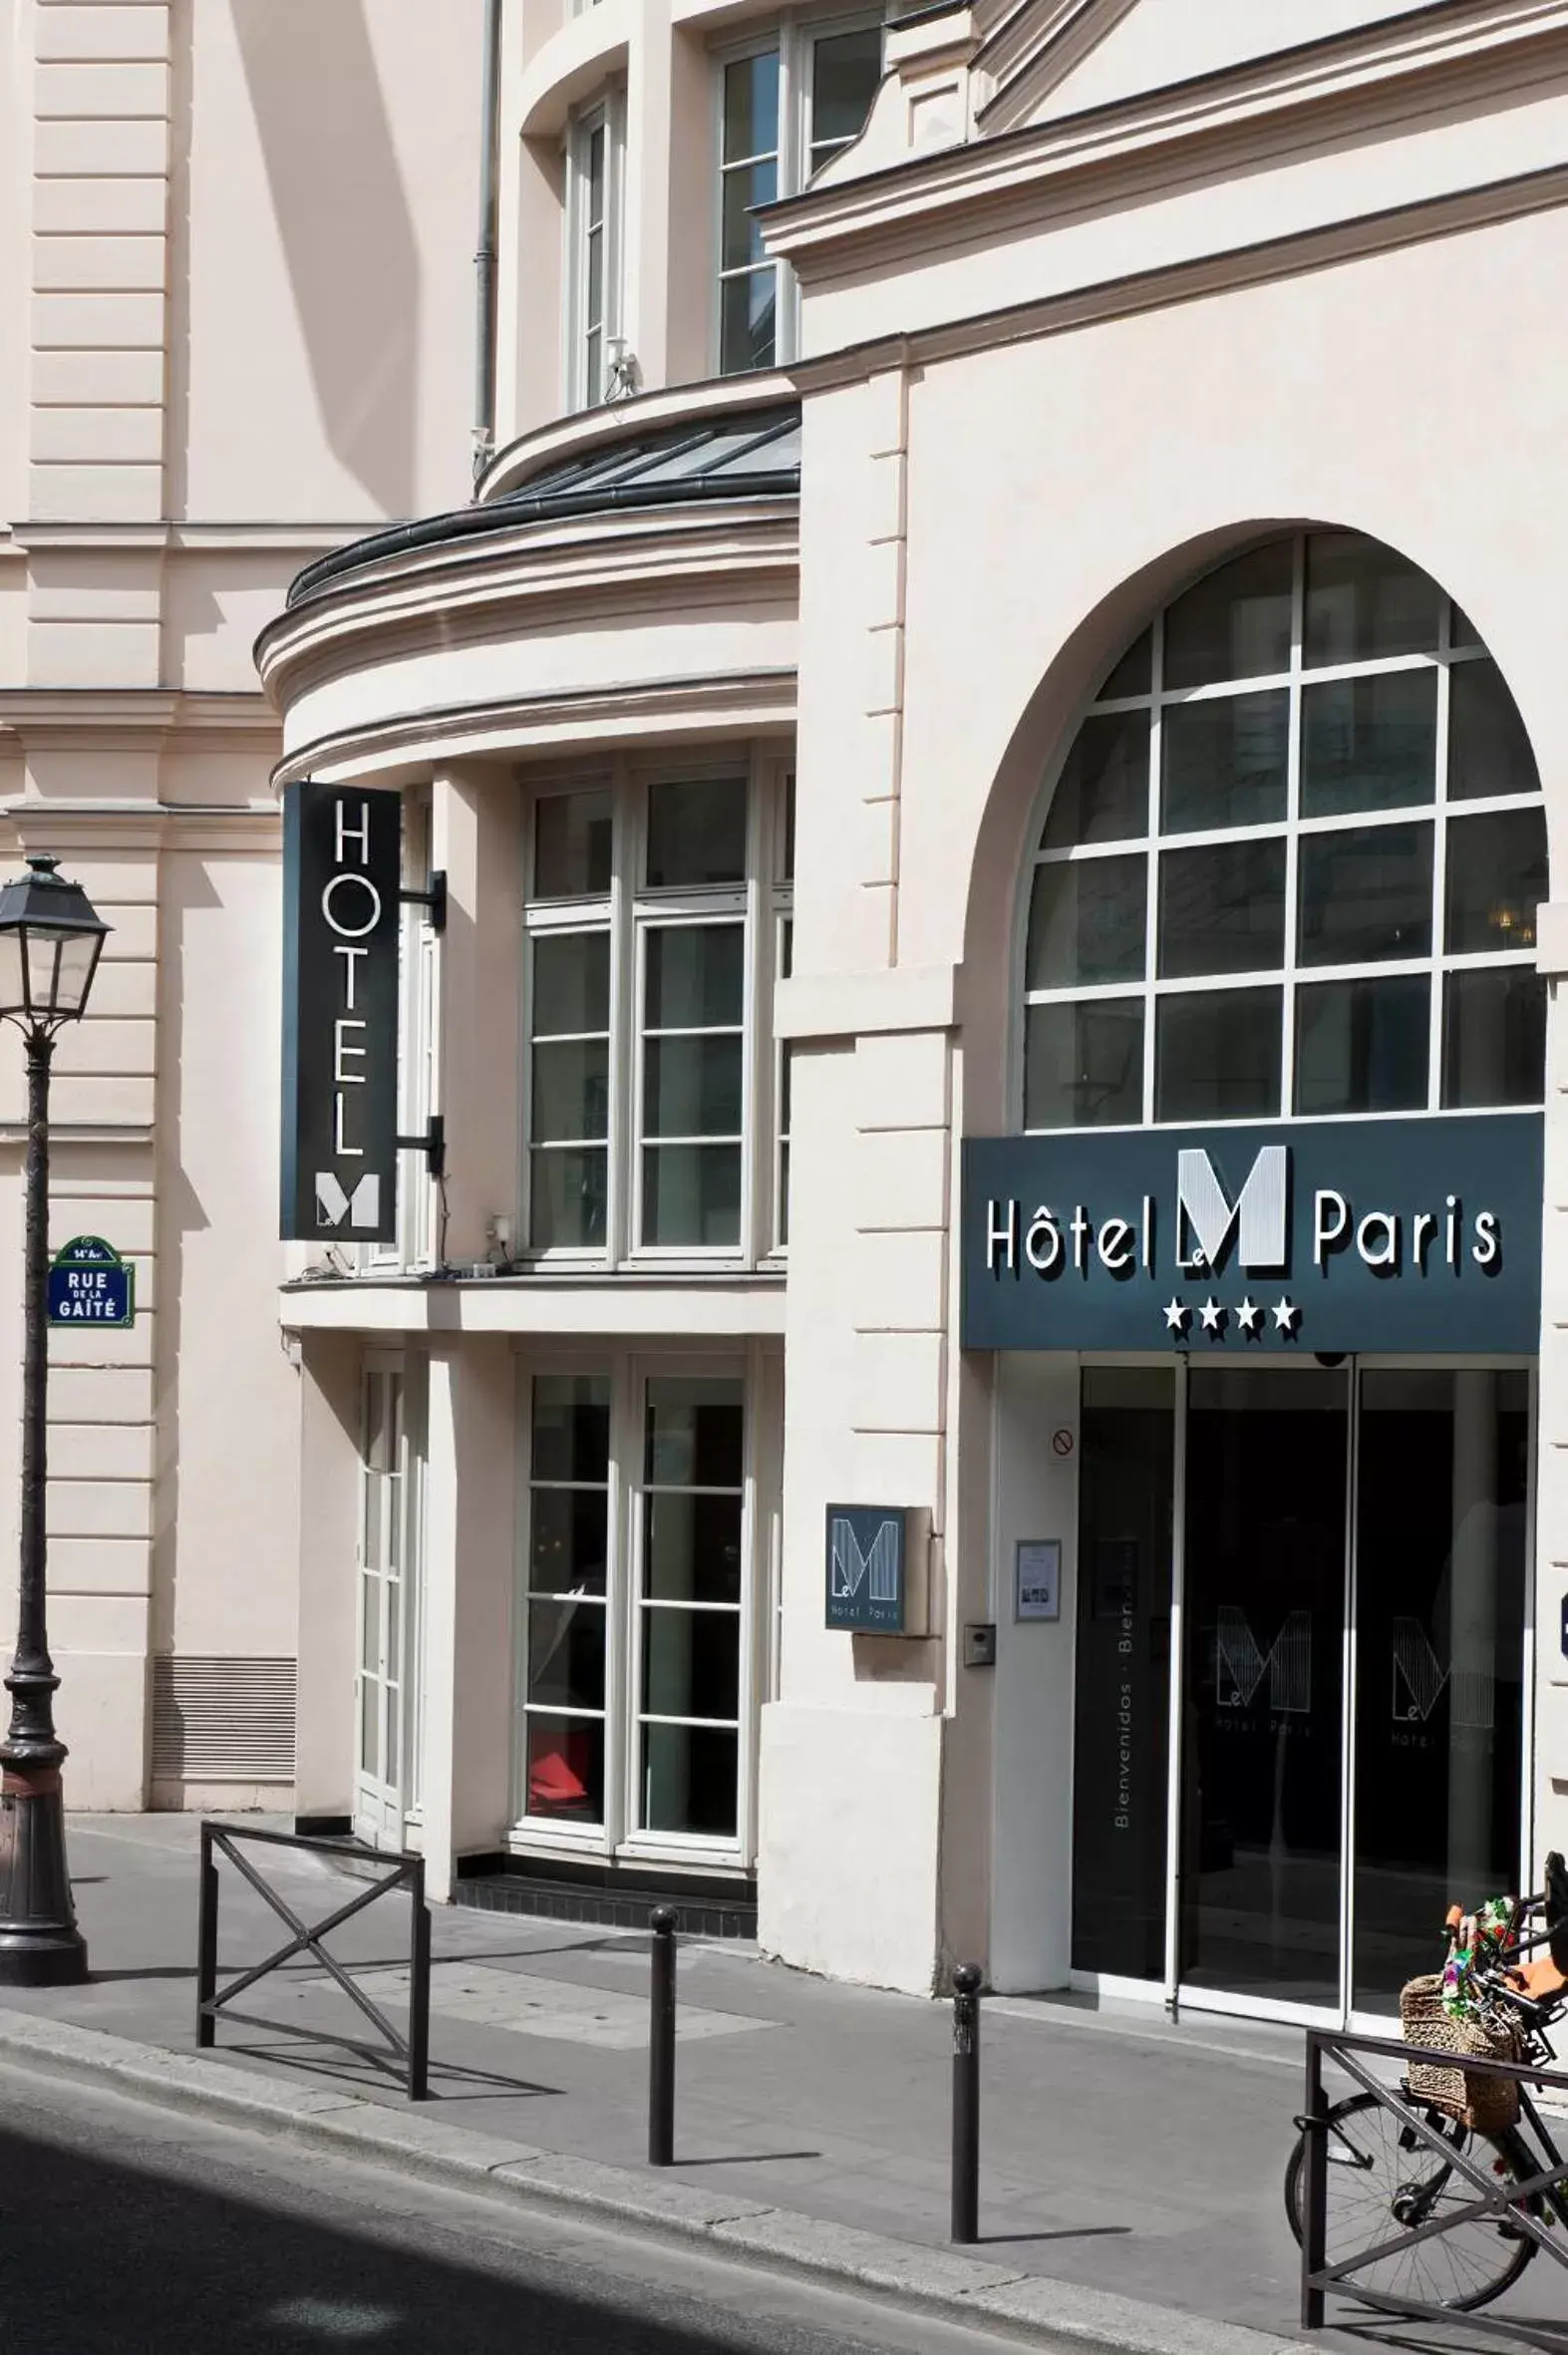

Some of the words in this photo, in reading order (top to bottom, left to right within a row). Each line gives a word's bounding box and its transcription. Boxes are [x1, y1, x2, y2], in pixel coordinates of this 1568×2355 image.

[322, 800, 381, 1156] HOTEL
[315, 1172, 381, 1228] M
[986, 1195, 1149, 1270] Hôtel
[1177, 1145, 1287, 1267] M
[1313, 1189, 1497, 1267] Paris
[59, 1298, 116, 1317] GAÎTÉ
[69, 1272, 107, 1288] RUE
[73, 1289, 86, 1298] DE
[90, 1289, 102, 1298] LA
[831, 1518, 898, 1601] M
[1115, 1682, 1132, 1829] Bienvenidos
